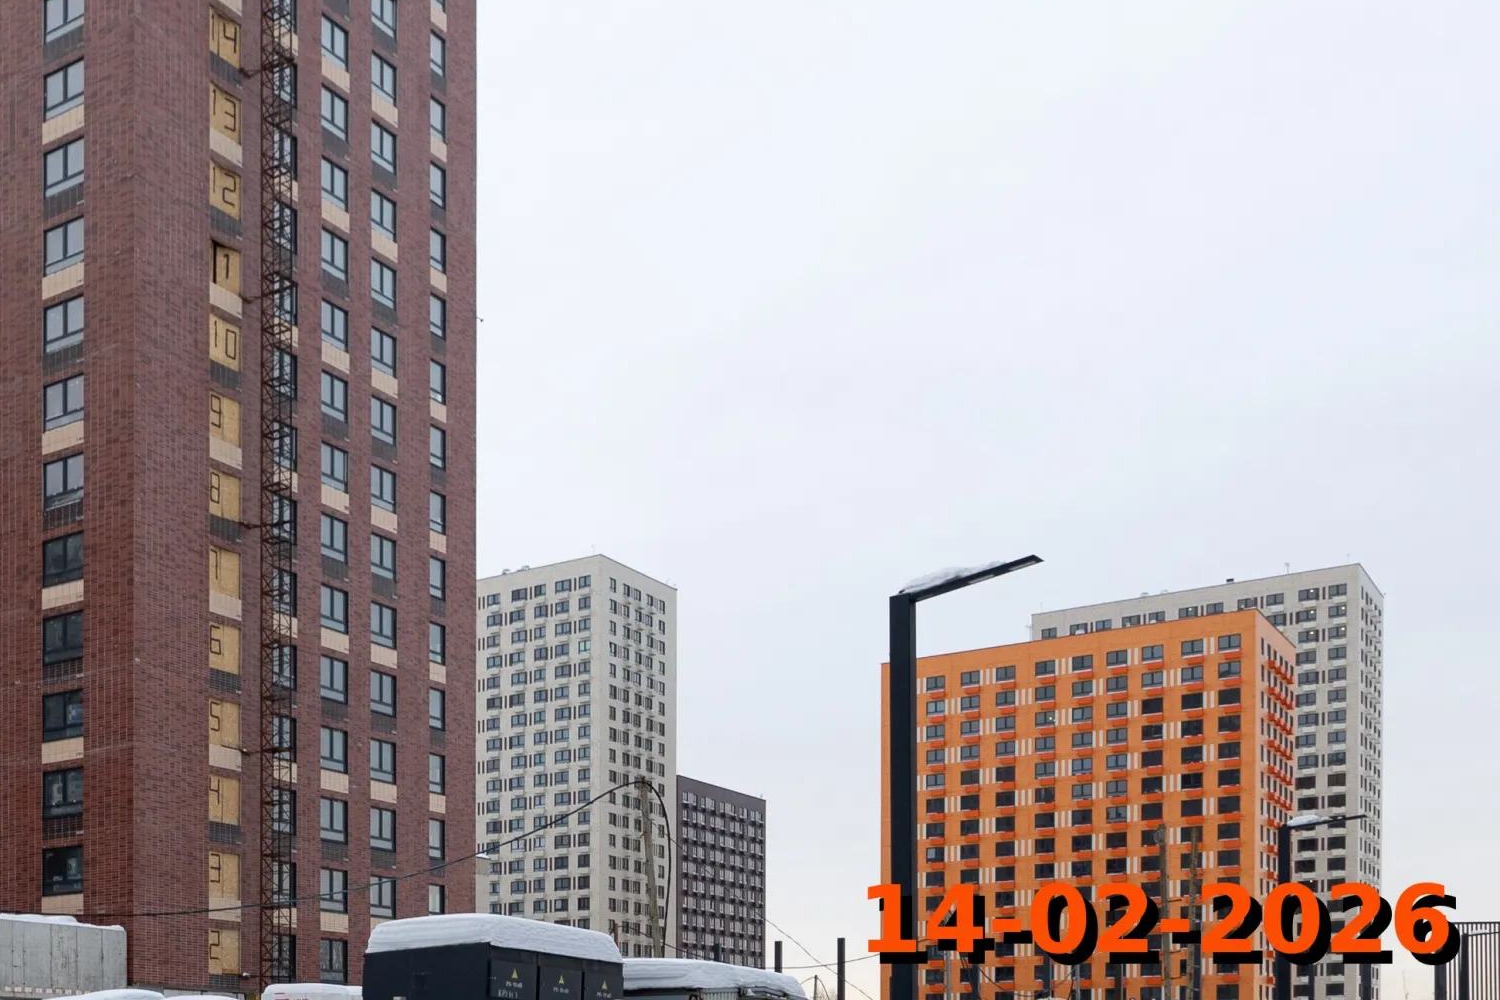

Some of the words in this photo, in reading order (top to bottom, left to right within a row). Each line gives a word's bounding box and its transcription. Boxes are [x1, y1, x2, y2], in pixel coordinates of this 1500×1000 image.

[212, 13, 237, 54] 14
[212, 88, 237, 132] 13
[213, 166, 236, 208] 12
[215, 319, 237, 361] 10
[211, 394, 221, 429] 9
[210, 471, 220, 504] 8
[209, 549, 218, 580] 7
[210, 625, 221, 656] 6
[210, 701, 220, 732] 5
[209, 777, 220, 806] 4
[210, 853, 220, 883] 3
[210, 930, 220, 960] 2
